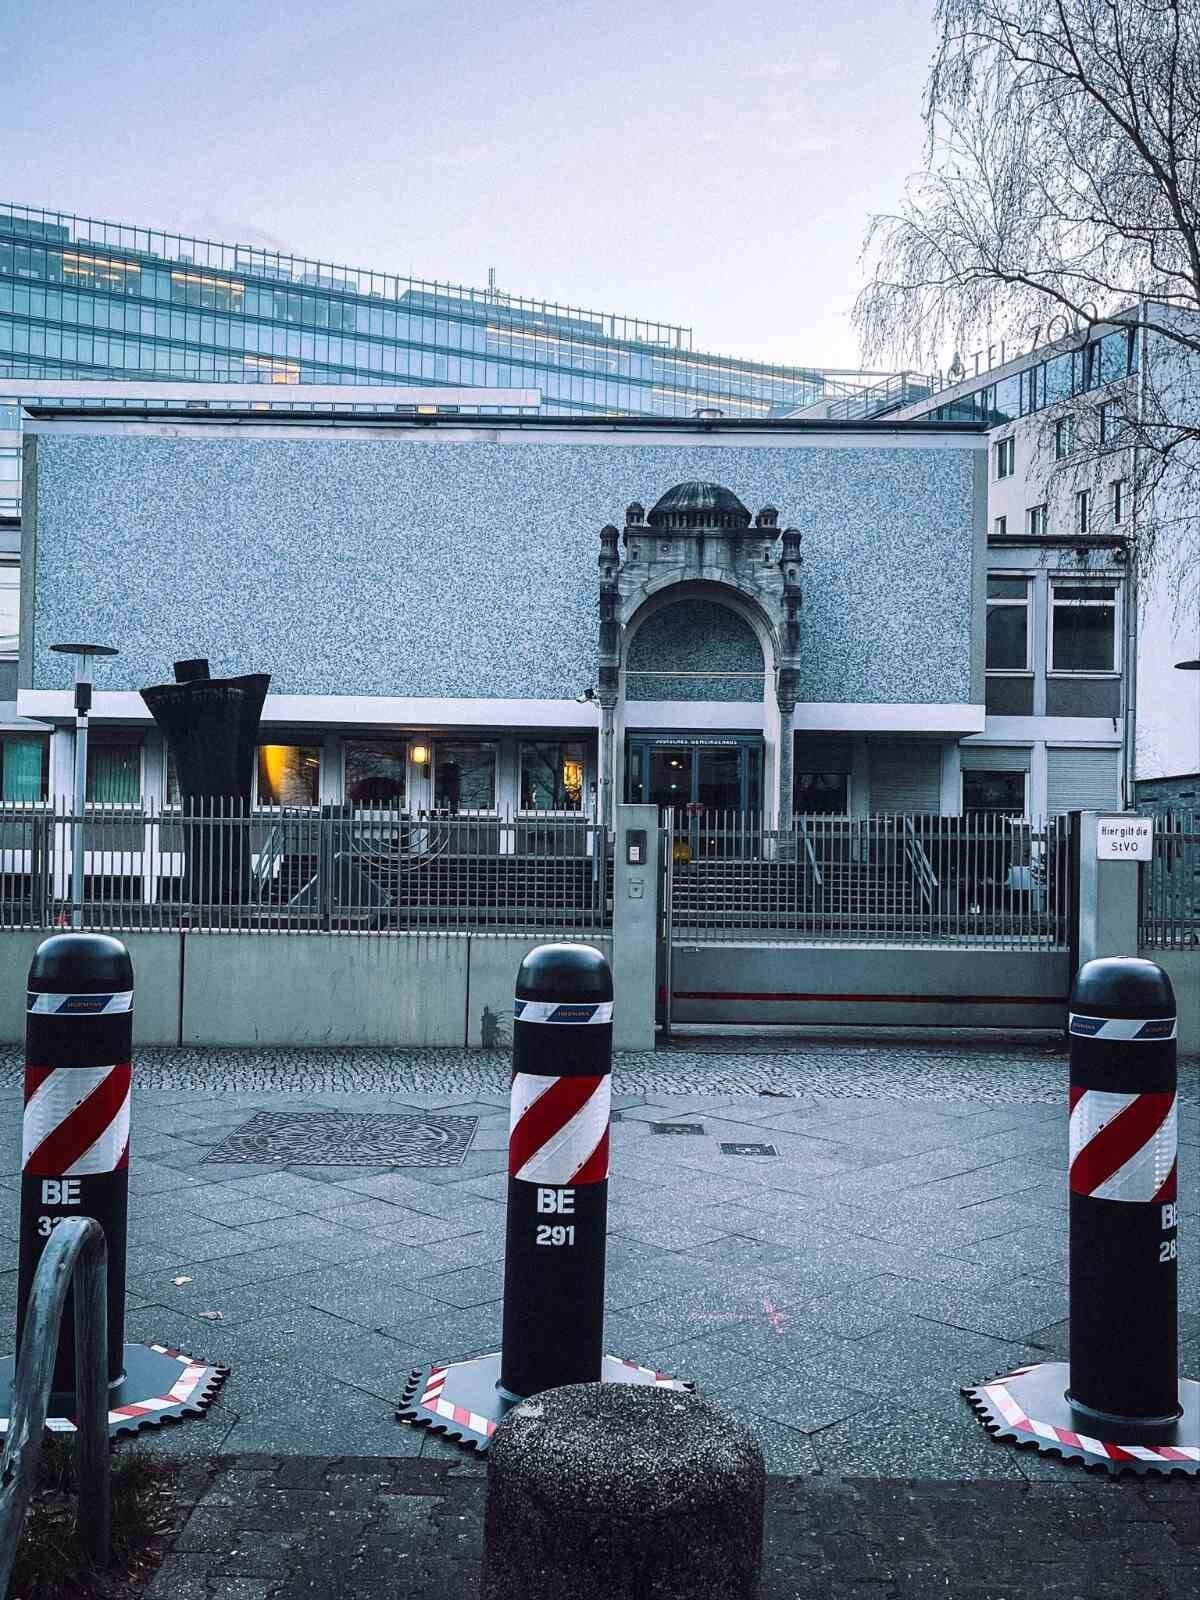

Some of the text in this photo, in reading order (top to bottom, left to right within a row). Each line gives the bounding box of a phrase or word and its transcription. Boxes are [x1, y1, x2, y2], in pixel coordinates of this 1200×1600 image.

[1102, 826, 1148, 838] Hier gilt die
[1111, 841, 1138, 852] StVO
[41, 1179, 81, 1205] BE
[537, 1187, 575, 1214] BE
[536, 1225, 575, 1246] 291
